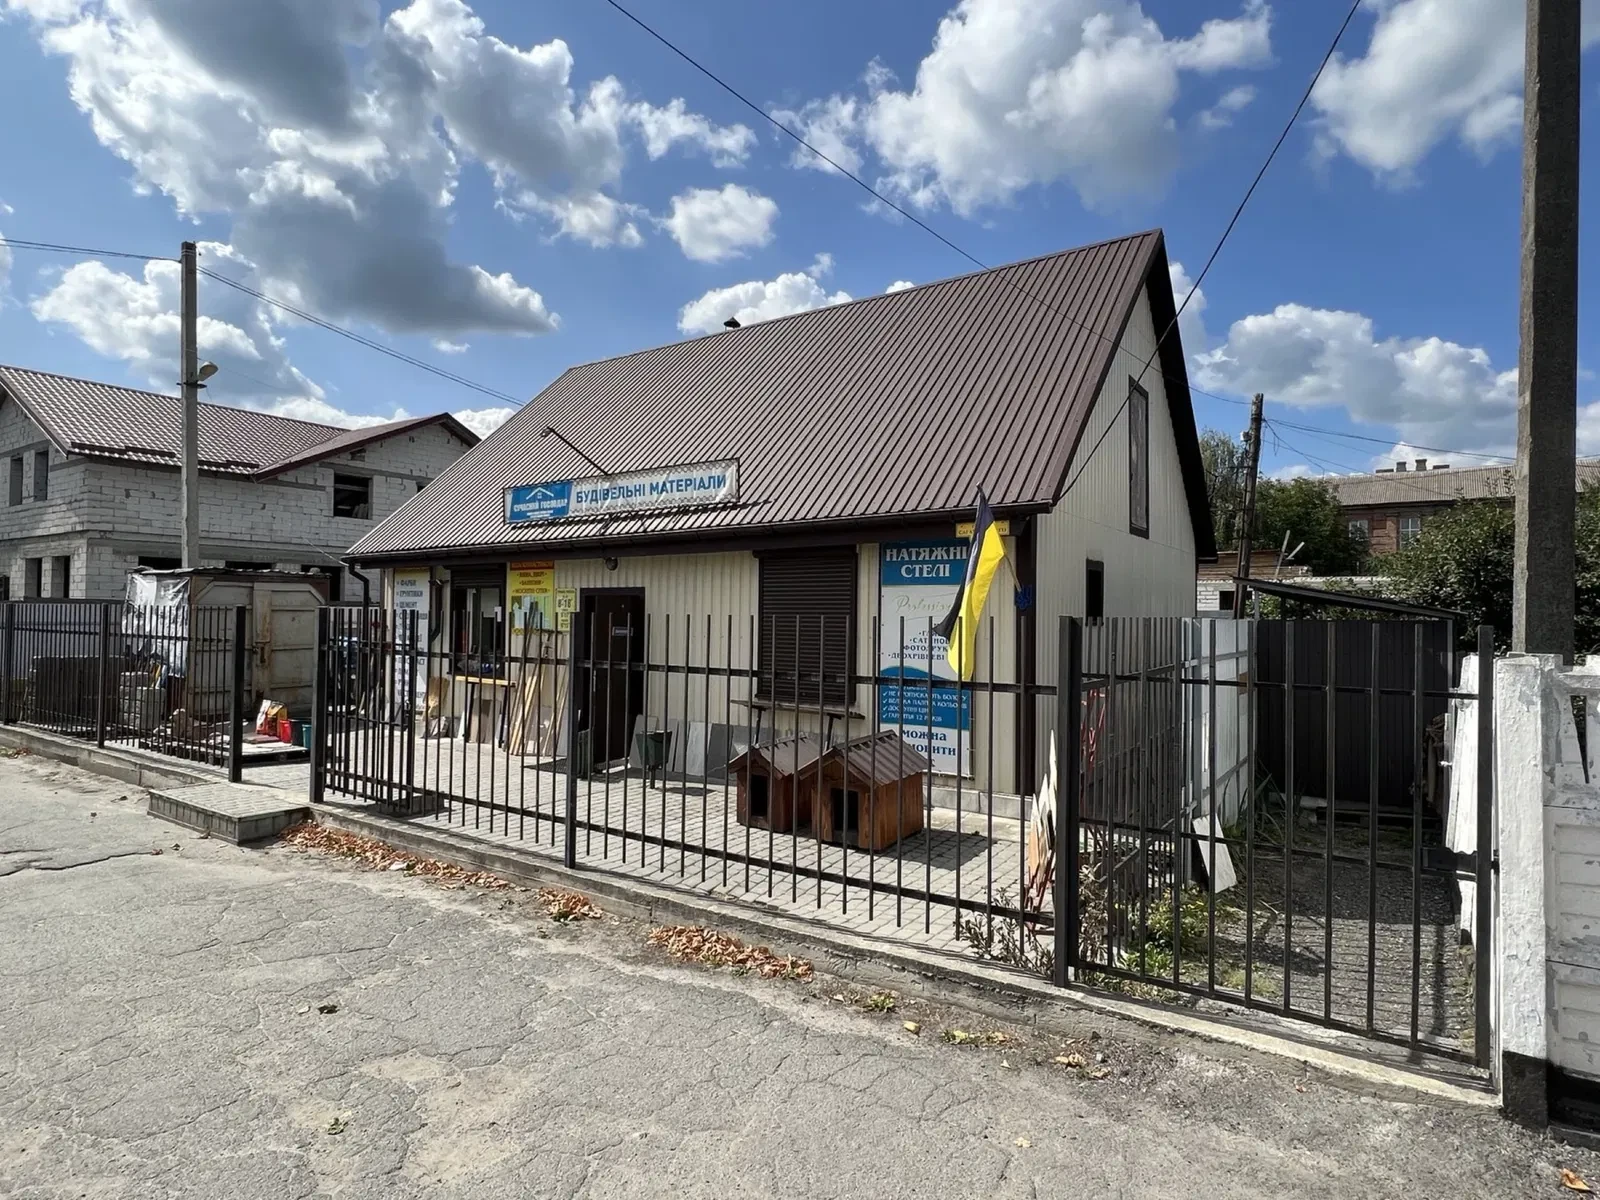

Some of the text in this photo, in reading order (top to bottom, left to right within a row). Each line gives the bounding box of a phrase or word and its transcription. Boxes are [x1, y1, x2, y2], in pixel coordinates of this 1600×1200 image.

[576, 474, 726, 504] БУДІВЕЛЬНІ МАТЕРІАЛИ
[513, 499, 568, 512] СУЧАСНИЙ ГОСПОДАР
[885, 546, 968, 561] НАТЯЖНІ
[900, 563, 951, 578] СТЕЛІ
